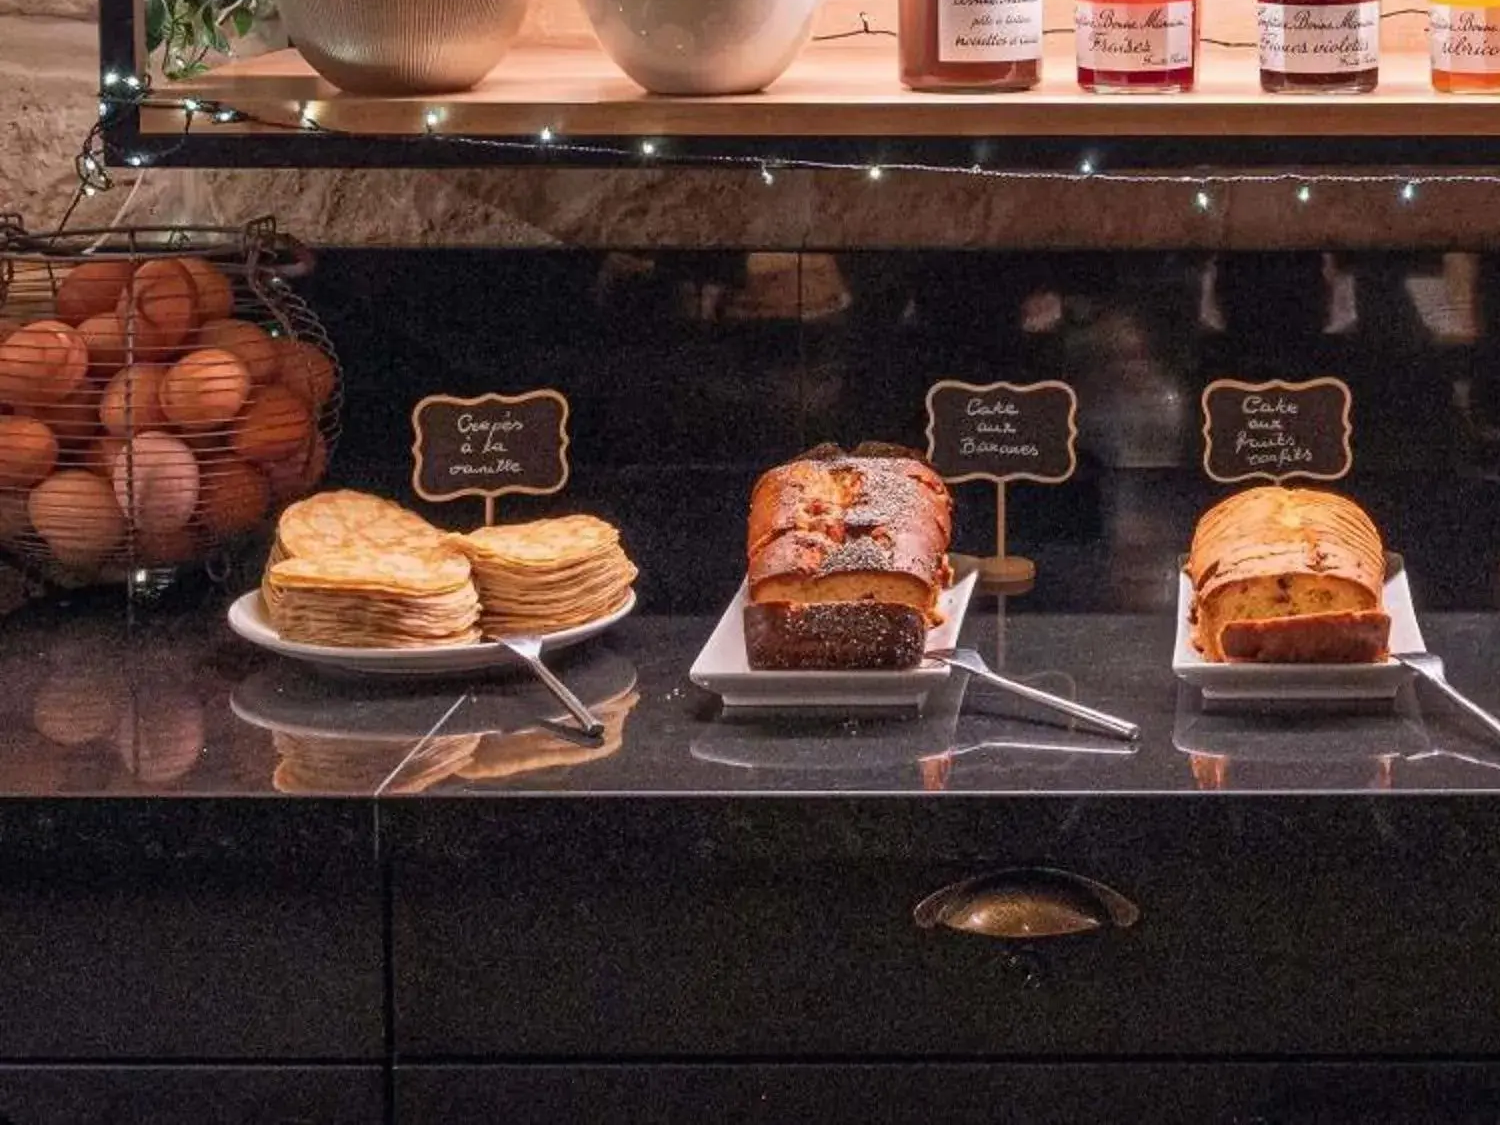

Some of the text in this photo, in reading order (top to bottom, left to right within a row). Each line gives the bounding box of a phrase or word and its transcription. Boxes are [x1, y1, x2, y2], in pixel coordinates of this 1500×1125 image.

[1089, 32, 1151, 53] Fraises
[966, 398, 1019, 416] Cake
[1242, 395, 1299, 414] Cake
[1248, 419, 1283, 430] aux
[482, 434, 508, 453] la
[960, 437, 1039, 456] Bananes
[1234, 430, 1296, 455] fruits
[449, 459, 524, 475] vanille
[1248, 447, 1313, 468] confits
